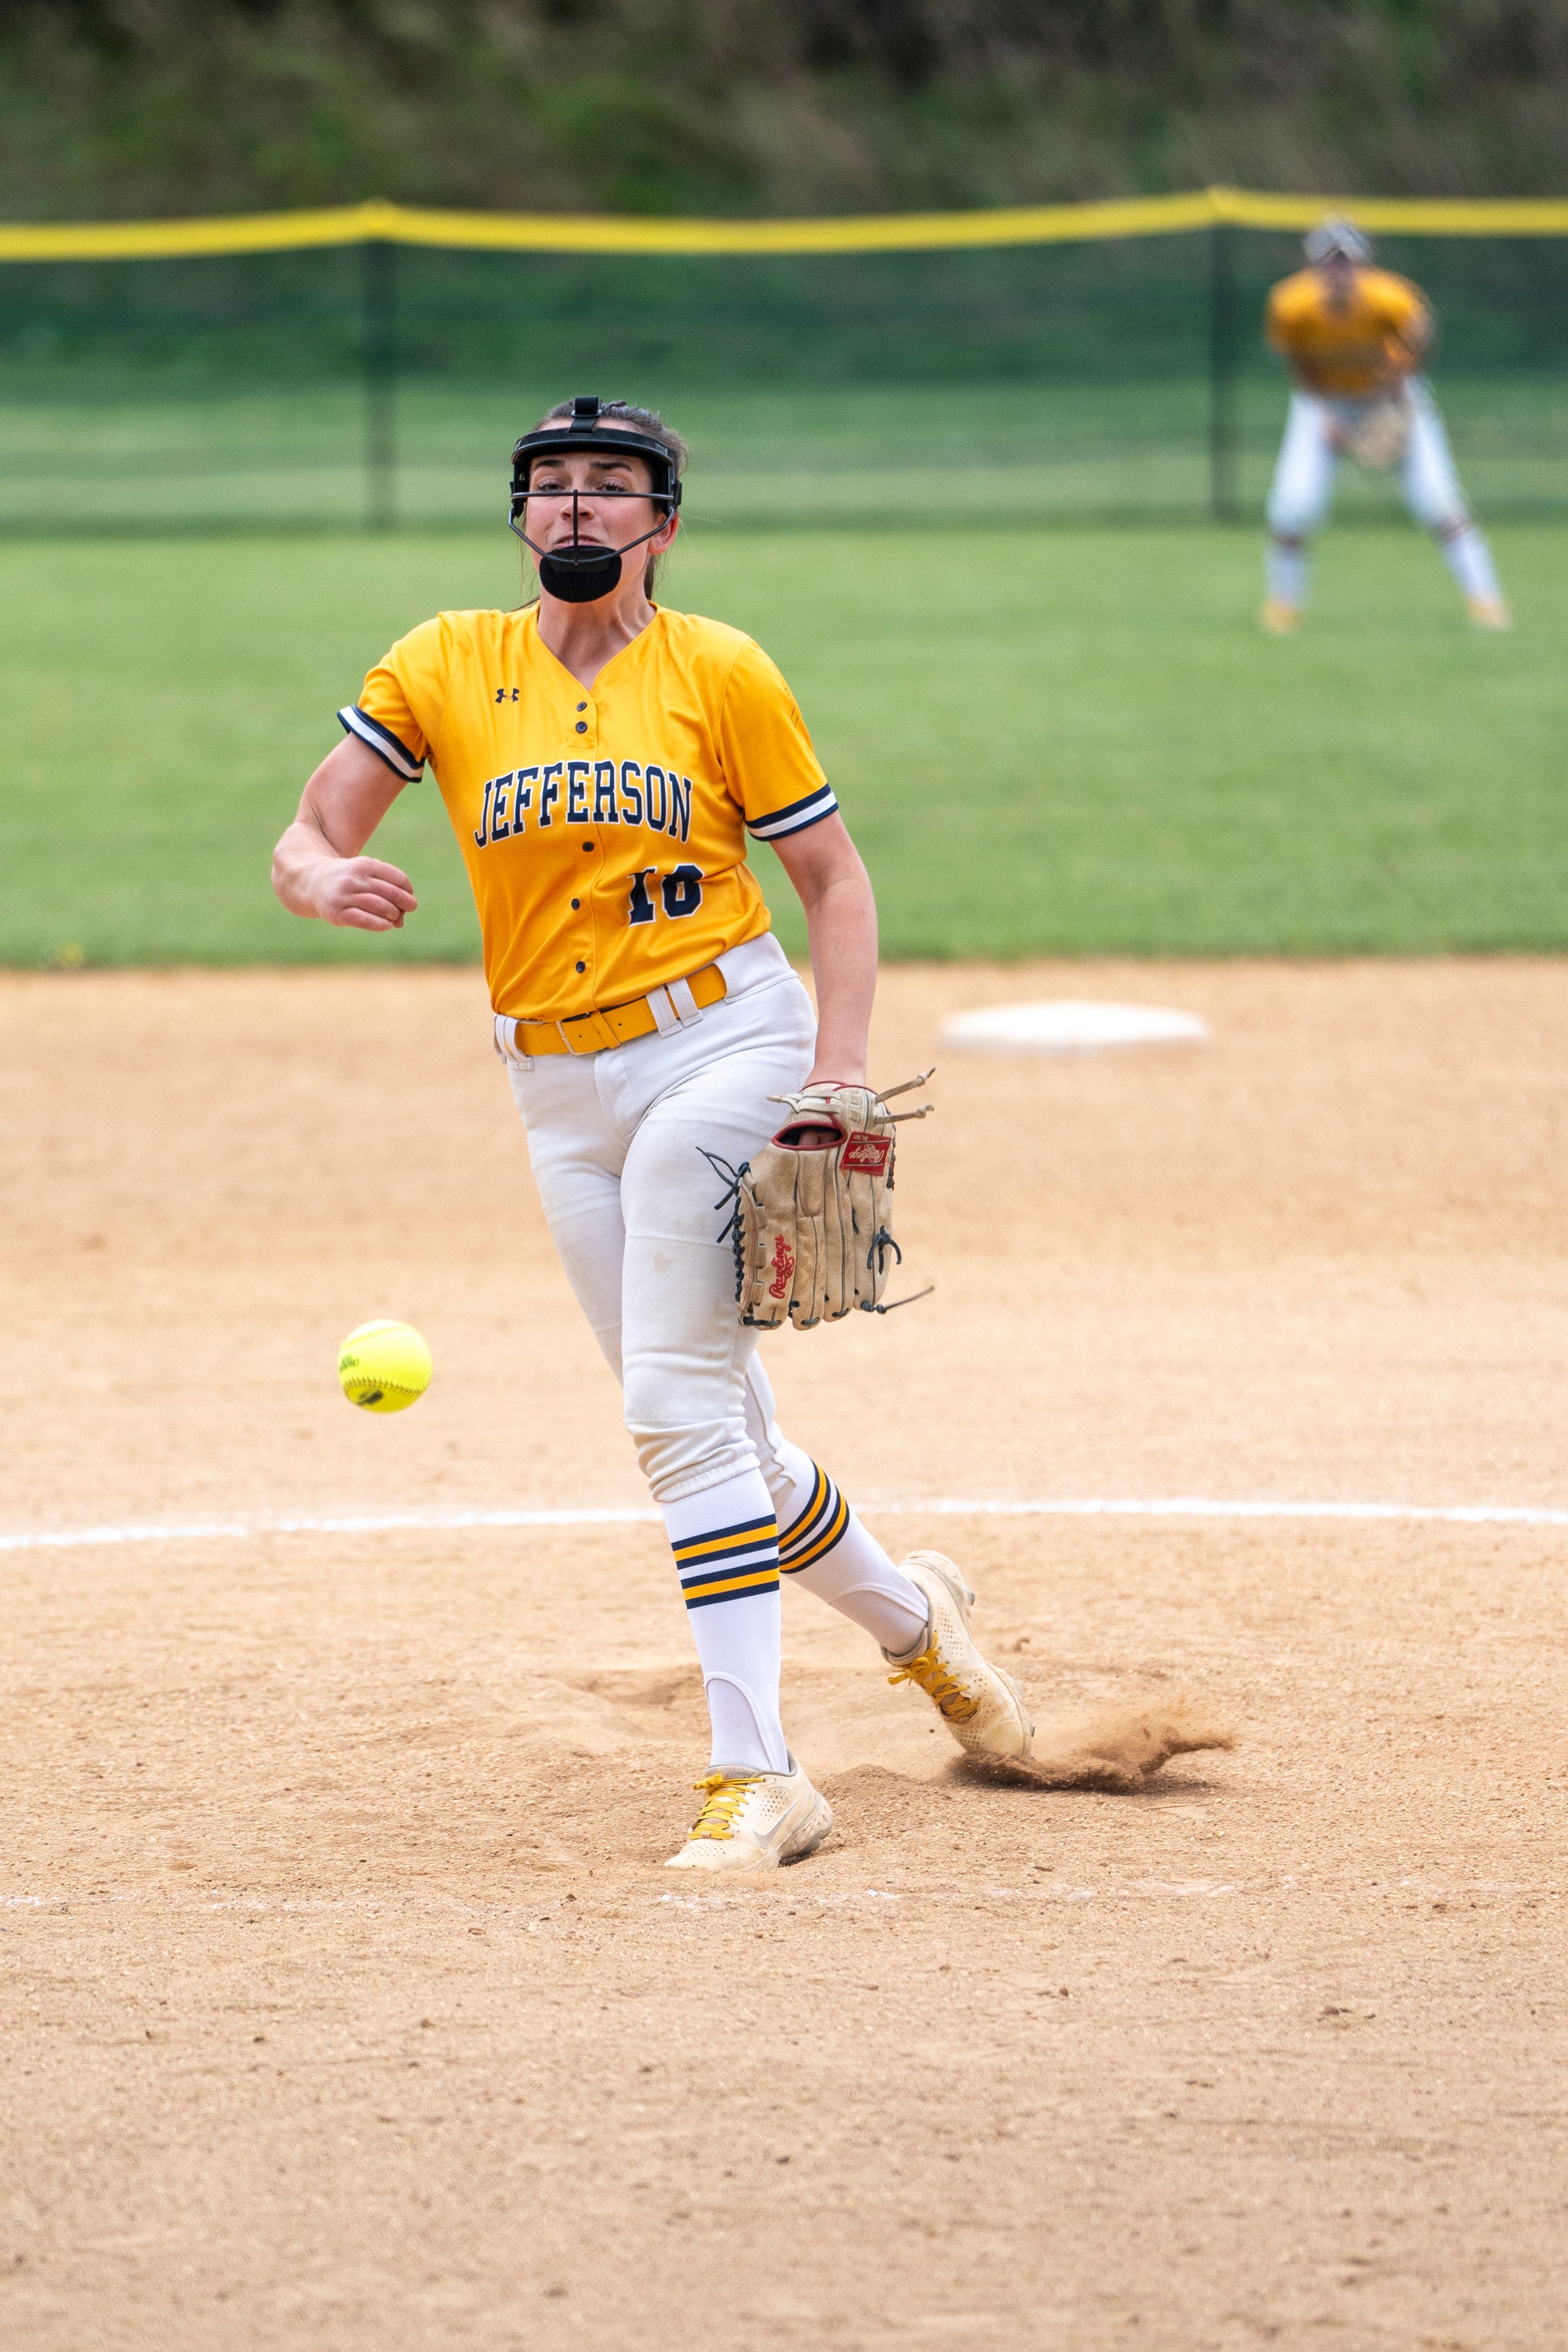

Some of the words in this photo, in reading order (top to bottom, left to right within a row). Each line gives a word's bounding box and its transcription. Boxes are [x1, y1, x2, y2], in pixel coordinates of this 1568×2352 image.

[474, 759, 692, 849] JEFFERSON
[627, 863, 705, 928] 10
[848, 1145, 885, 1163] Rawlings
[769, 1234, 793, 1299] Rawlings
